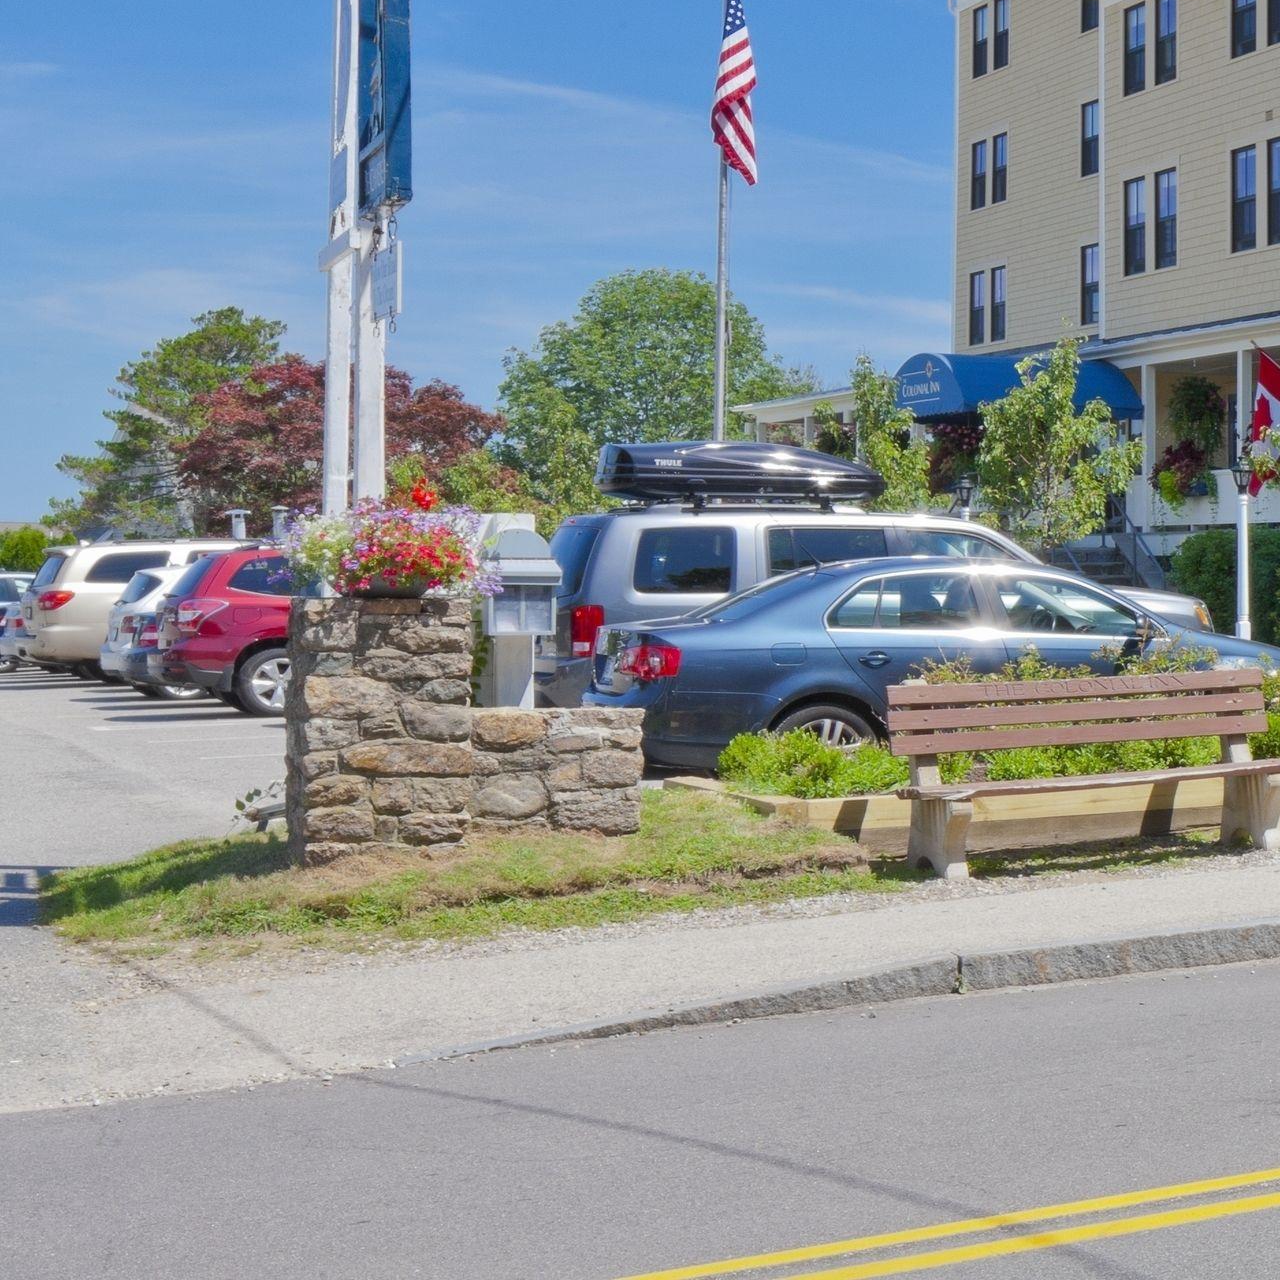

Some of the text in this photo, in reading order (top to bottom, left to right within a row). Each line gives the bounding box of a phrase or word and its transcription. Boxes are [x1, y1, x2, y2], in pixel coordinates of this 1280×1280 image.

[902, 382, 930, 398] COLONIAL
[654, 458, 682, 467] THULE
[977, 682, 1025, 699] THE
[1034, 676, 1142, 695] COLONIAL
